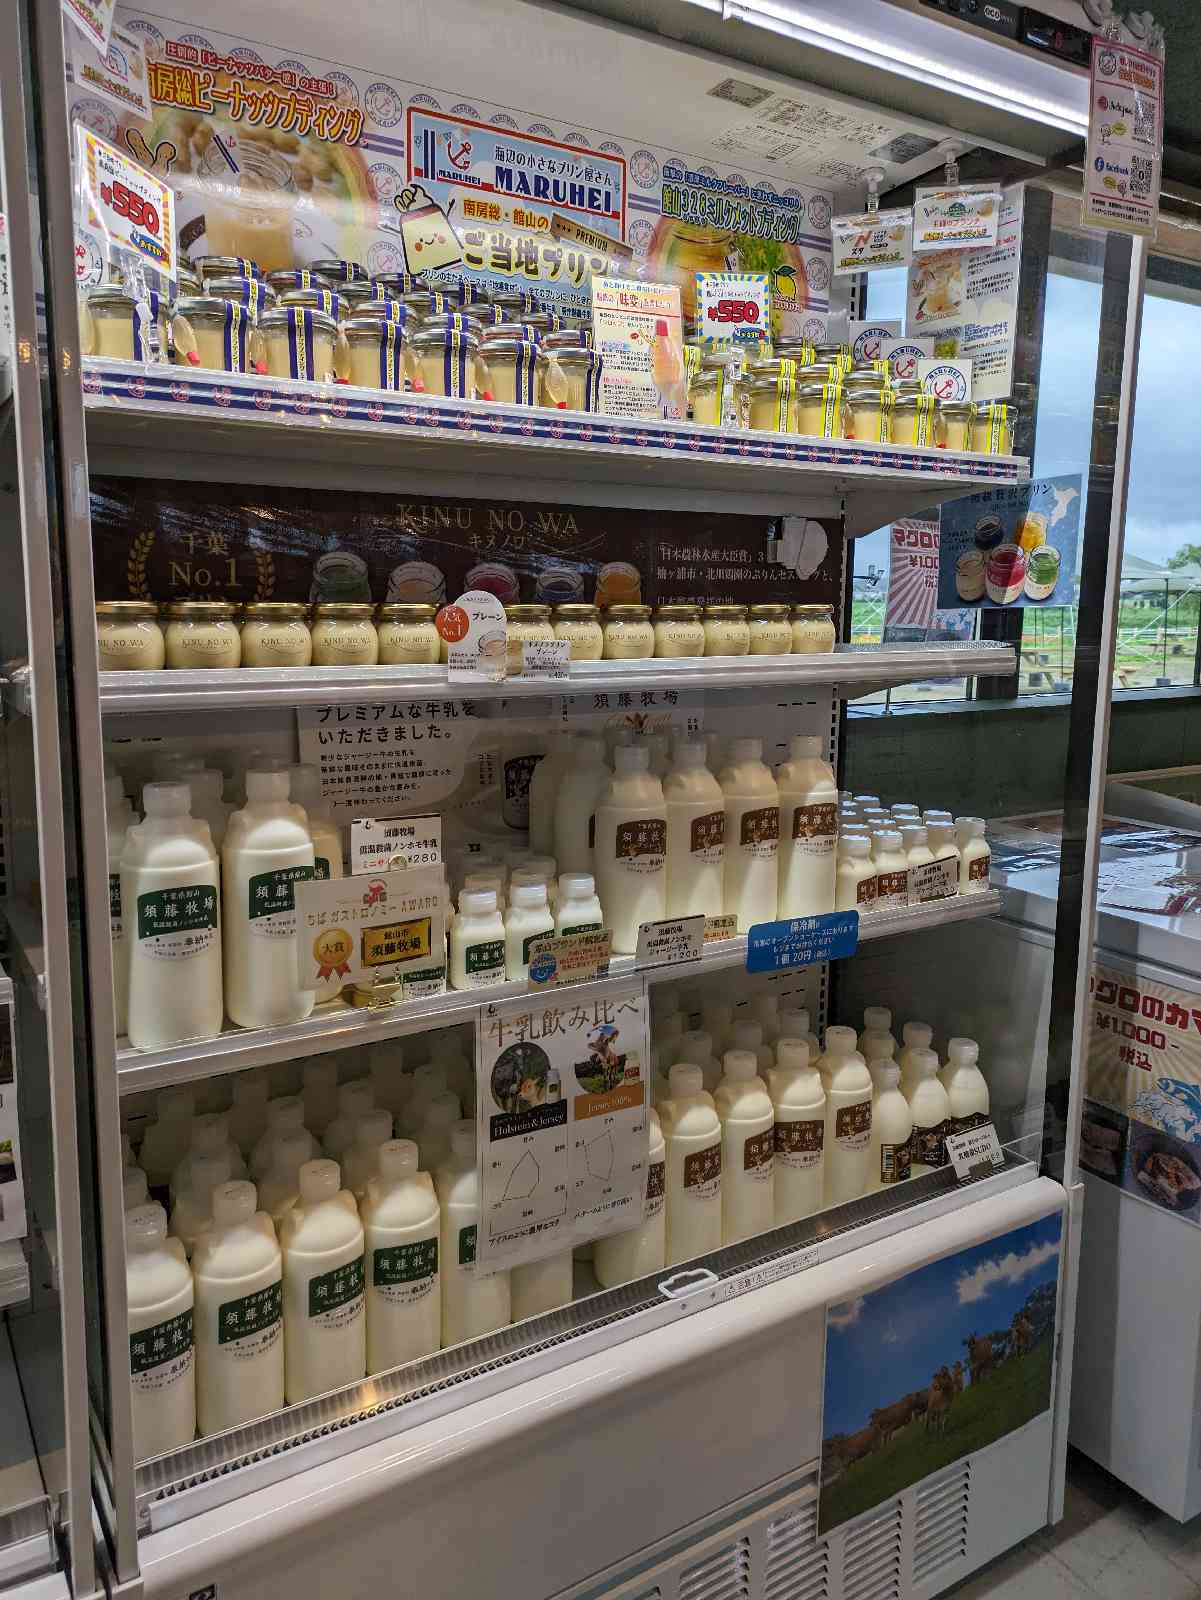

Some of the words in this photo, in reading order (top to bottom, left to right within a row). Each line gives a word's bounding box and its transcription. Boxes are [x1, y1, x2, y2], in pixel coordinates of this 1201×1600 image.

[438, 168, 481, 186] MARUHEI
[494, 145, 612, 186] 海辺の小さなプリン屋さん
[494, 165, 612, 213] MARUHEI
[100, 181, 161, 236] ¥550
[463, 198, 550, 232] 南房総・館山の
[575, 226, 610, 252] PREMIUM
[707, 299, 760, 324] ¥550
[397, 503, 473, 529] KINU
[488, 509, 524, 532] NO
[537, 510, 579, 534] WA
[892, 527, 939, 549] マグロ
[168, 558, 243, 588] No.1
[471, 612, 504, 622] プレーン
[315, 701, 480, 724] プレミアムな牛乳を
[318, 723, 452, 746] いただきました。
[407, 853, 438, 865] ¥280
[143, 895, 216, 919] 須藤牧場
[371, 937, 422, 957] 須藤牧場
[1090, 976, 1201, 1034] グロのカ
[490, 998, 641, 1048] 牛乳飲み比べ
[1118, 1046, 1153, 1073] 税込
